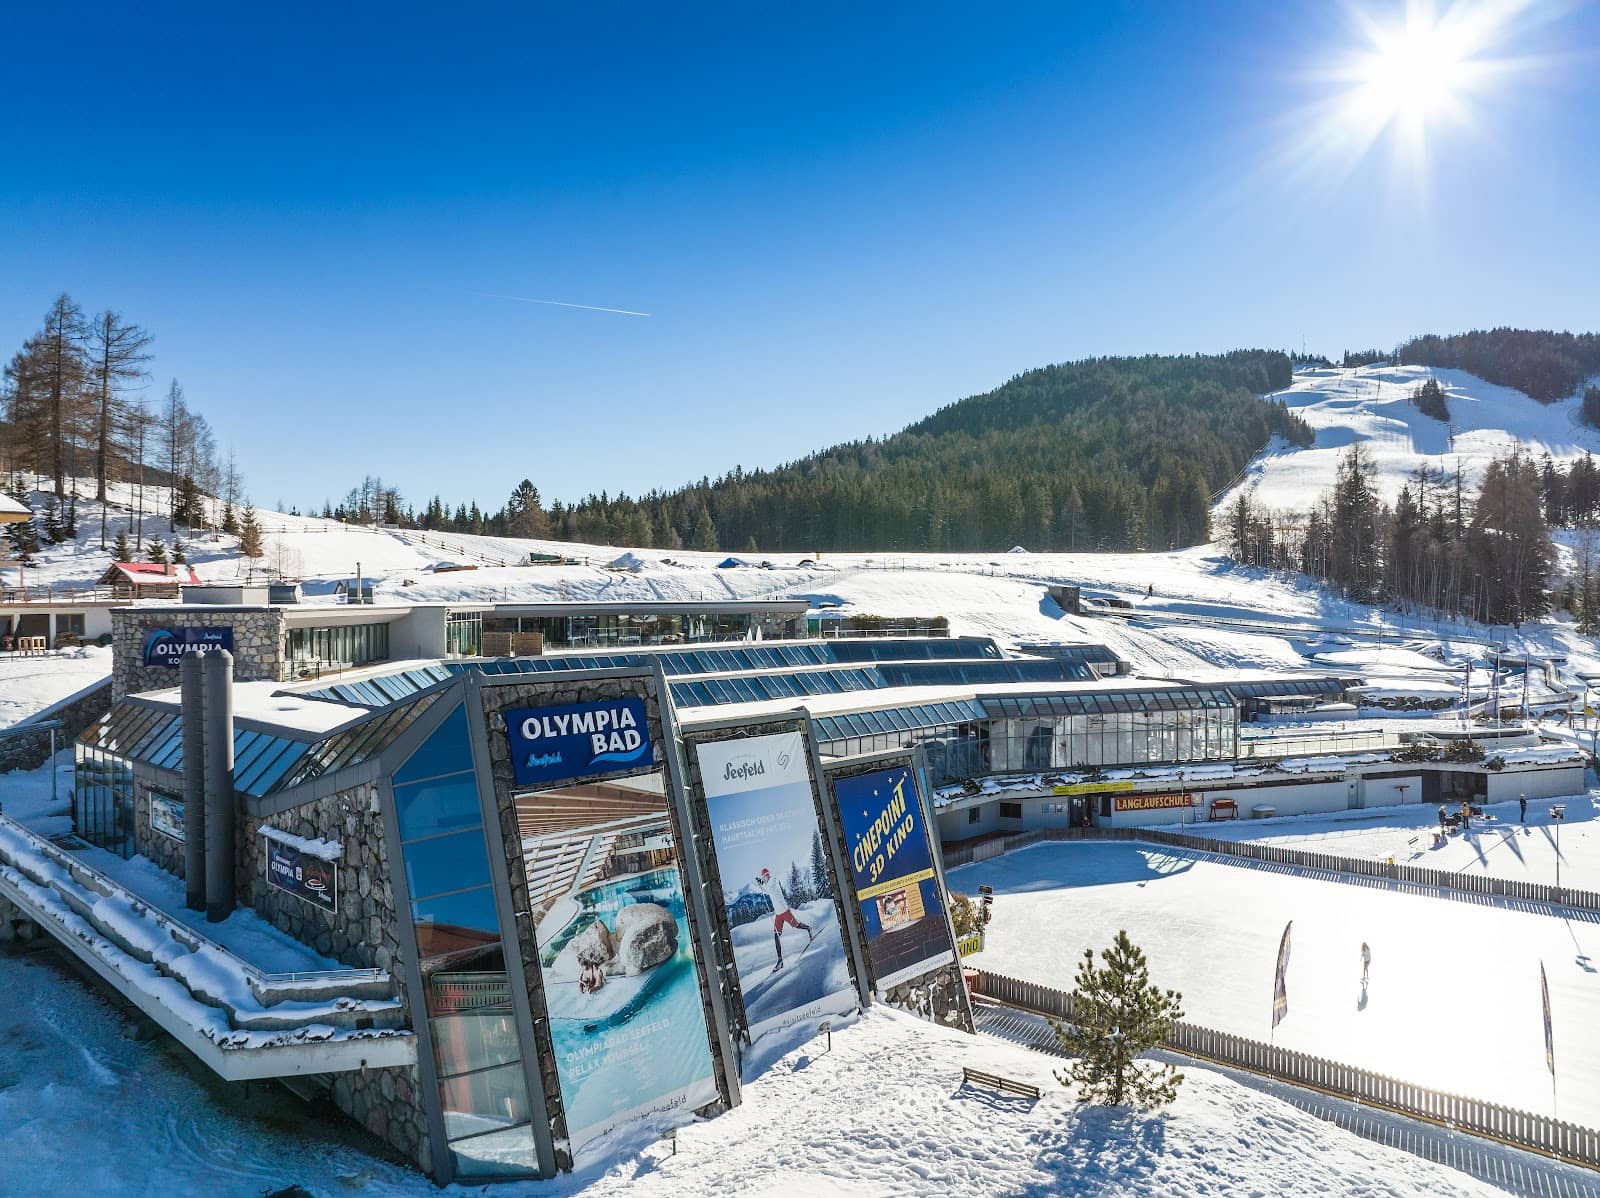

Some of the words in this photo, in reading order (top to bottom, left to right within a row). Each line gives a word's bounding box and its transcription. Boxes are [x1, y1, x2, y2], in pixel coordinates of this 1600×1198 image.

[522, 707, 636, 739] OLYMPIA
[592, 729, 641, 755] BAD
[723, 760, 765, 781] Seefeld
[1117, 794, 1190, 809] LANGLAUFSCHULE
[854, 777, 906, 873] CINEPOINT
[869, 854, 885, 883] 3D
[886, 814, 914, 860] KINO
[271, 861, 294, 878] OLYMPIA
